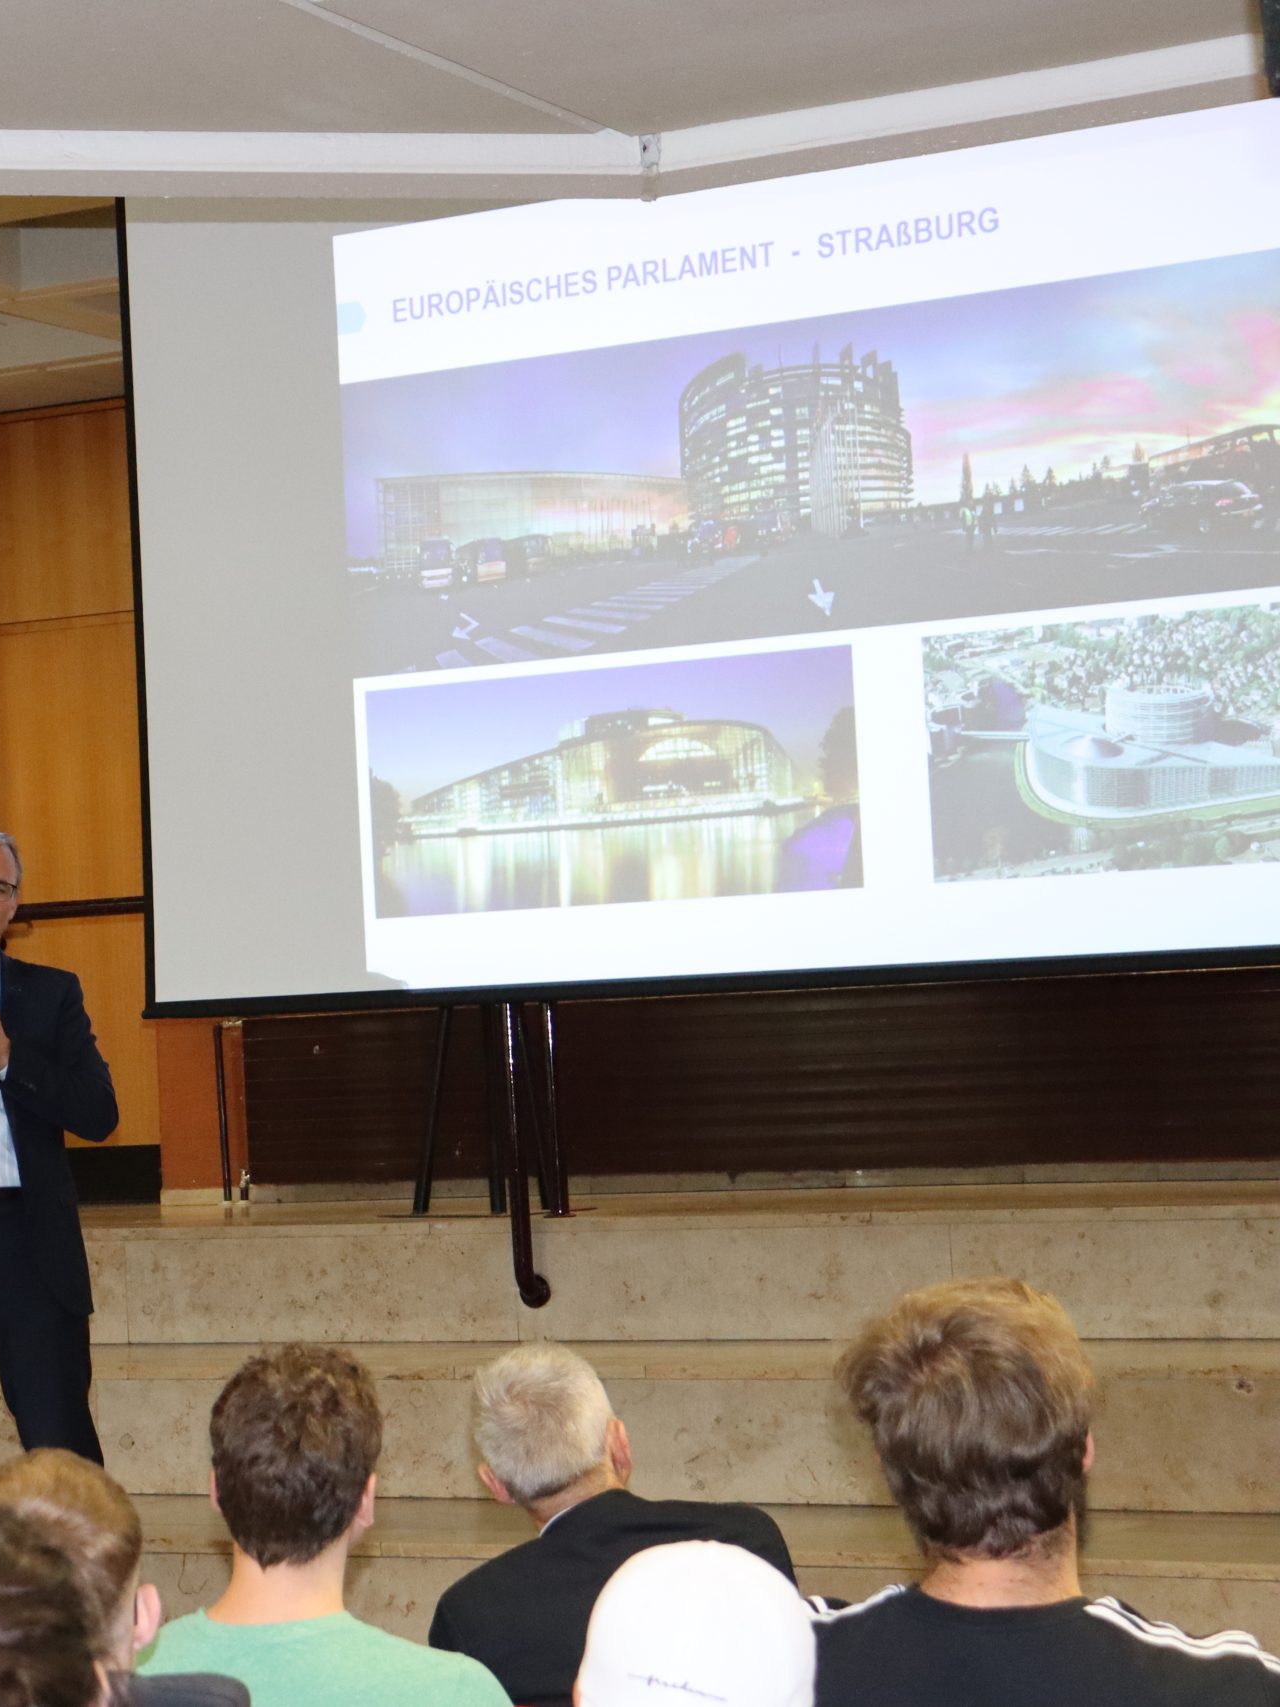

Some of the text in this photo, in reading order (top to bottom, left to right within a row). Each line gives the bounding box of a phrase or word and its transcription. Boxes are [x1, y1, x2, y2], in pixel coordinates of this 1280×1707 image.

[392, 269, 598, 323] EUROPÄISCHES
[606, 241, 774, 290] PARLAMENT
[817, 207, 1000, 259] STRAßBURG
